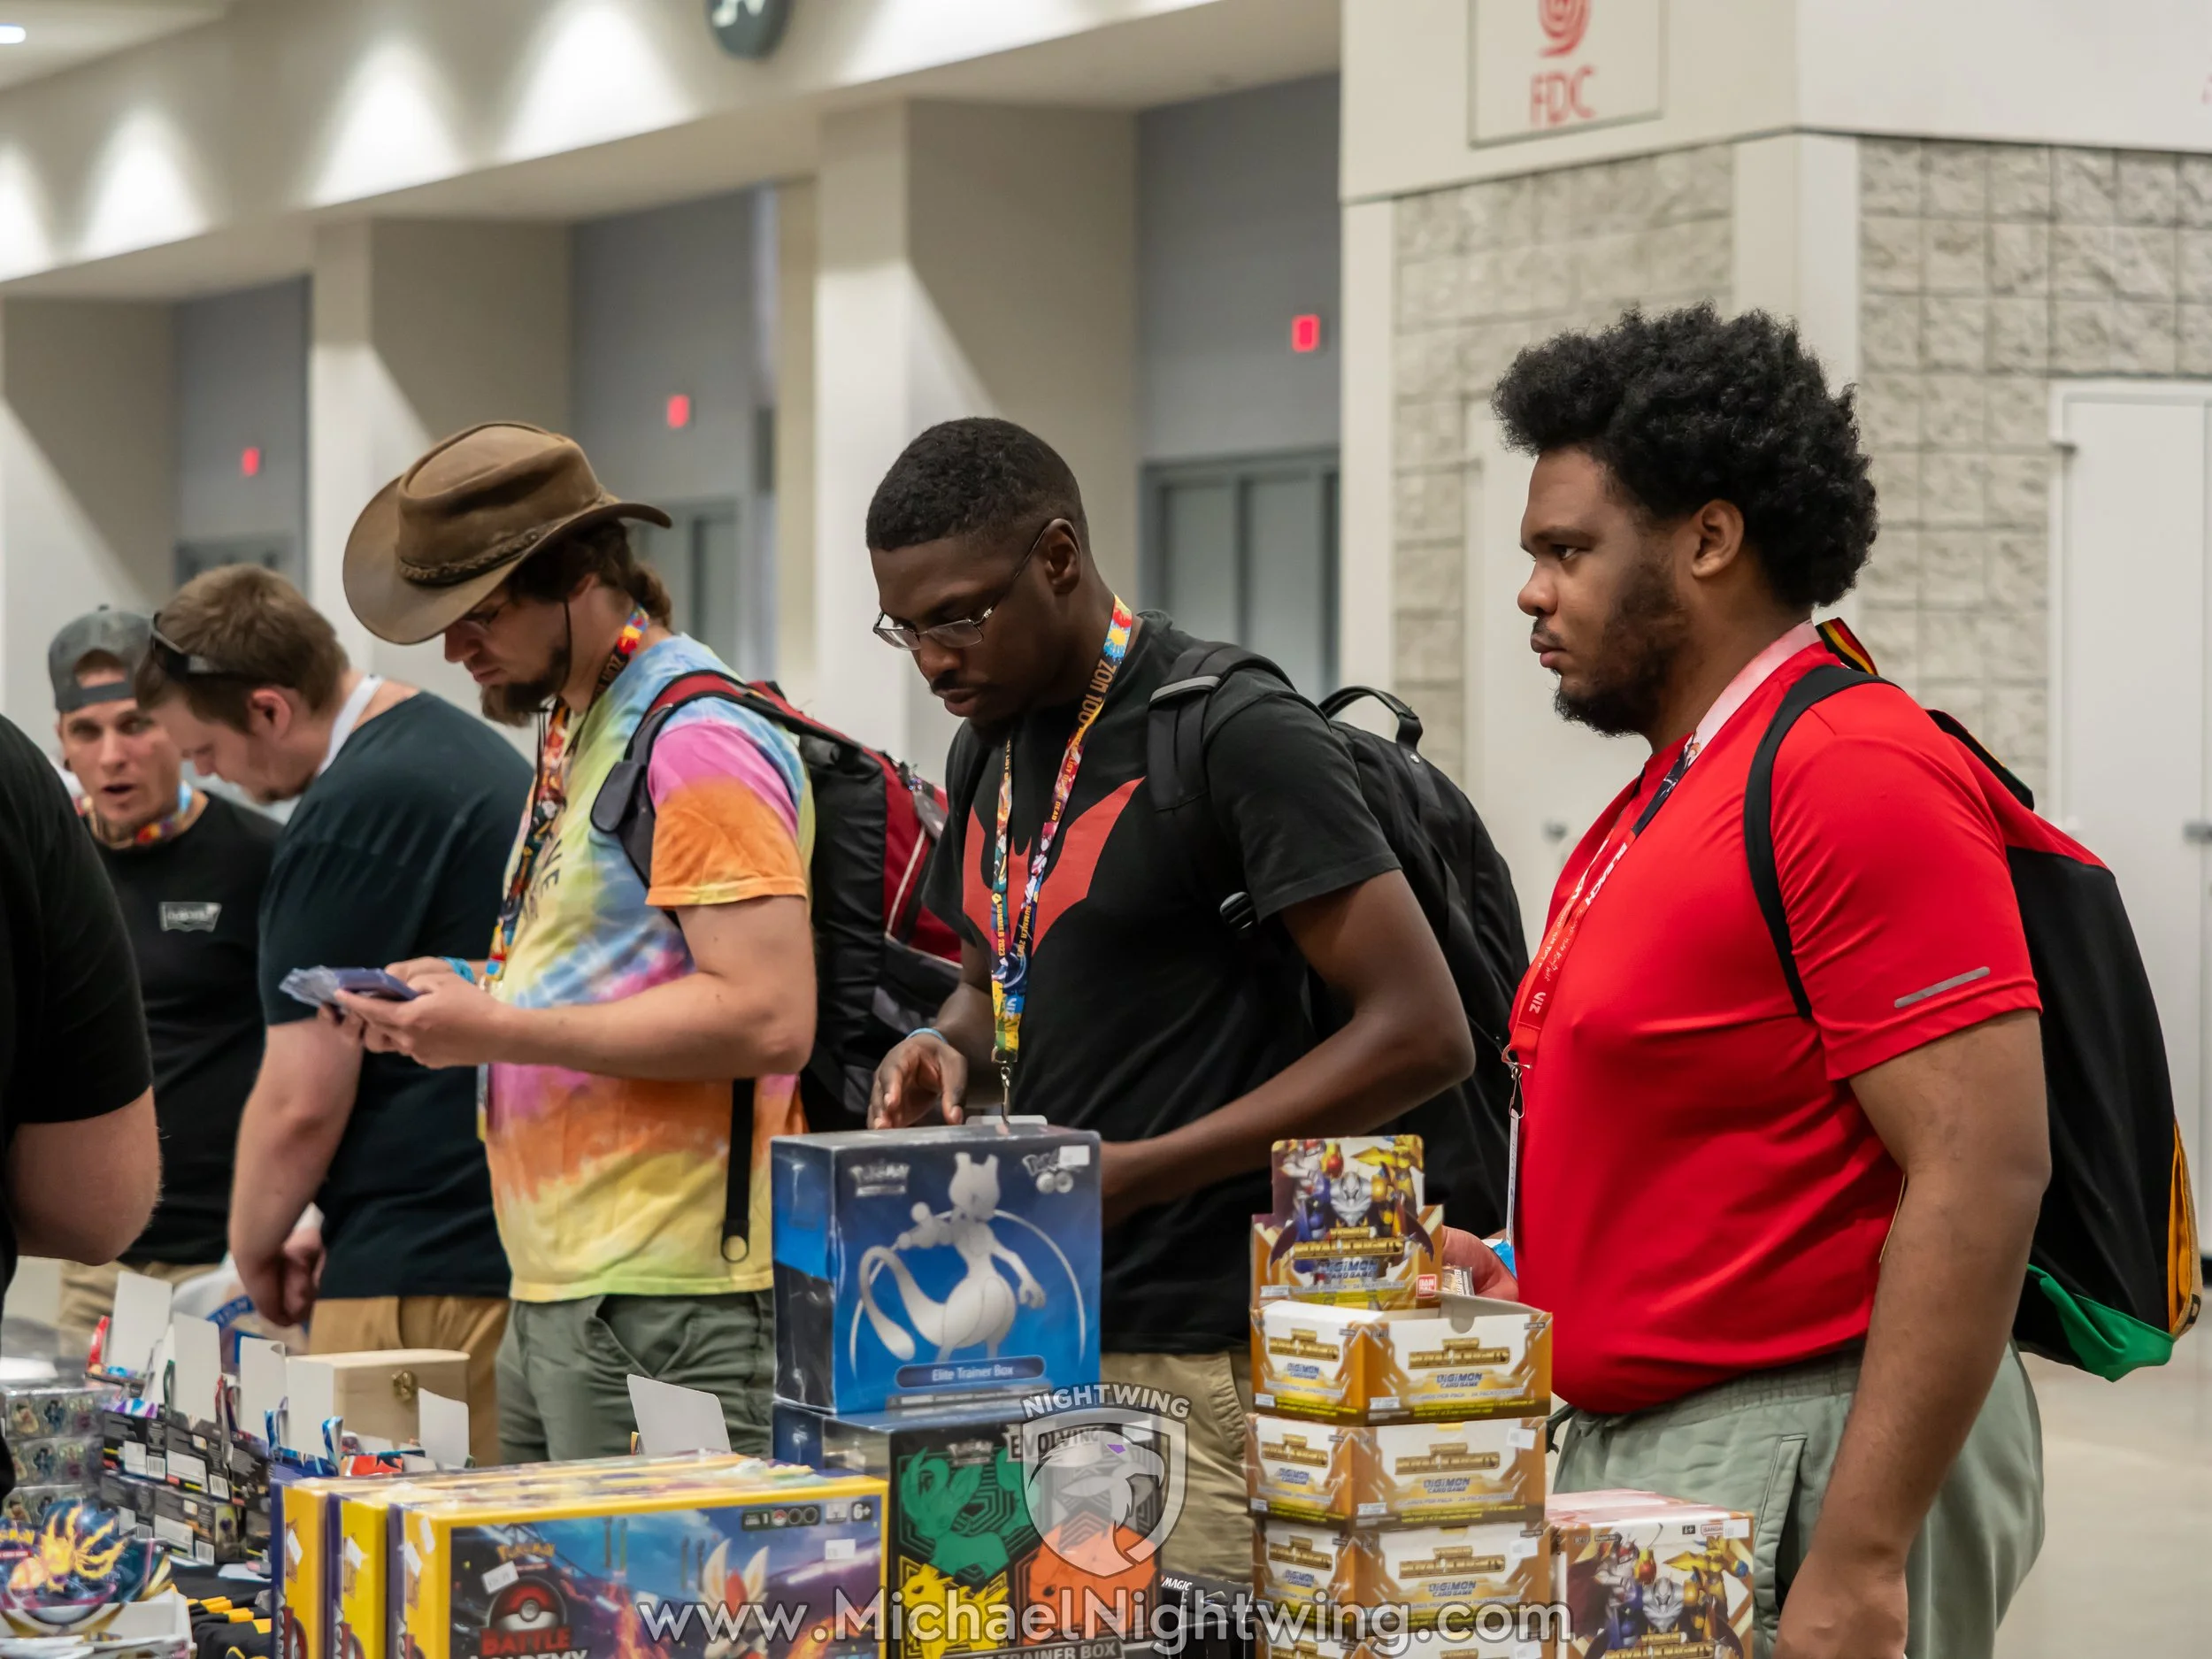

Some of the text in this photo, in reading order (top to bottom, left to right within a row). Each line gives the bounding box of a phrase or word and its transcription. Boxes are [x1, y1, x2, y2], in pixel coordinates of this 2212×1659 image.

[1531, 65, 1595, 128] FDC
[1585, 841, 1628, 906] BLEACH
[996, 903, 1005, 936] SUMMER
[1528, 991, 1547, 1014] VIZ
[958, 1365, 992, 1379] Trainer
[994, 1363, 1014, 1376] Box
[852, 1503, 872, 1521] 6+
[1161, 1577, 1193, 1591] MAGIC
[480, 1626, 571, 1655] BATTLE
[1080, 1641, 1117, 1659] BOX
